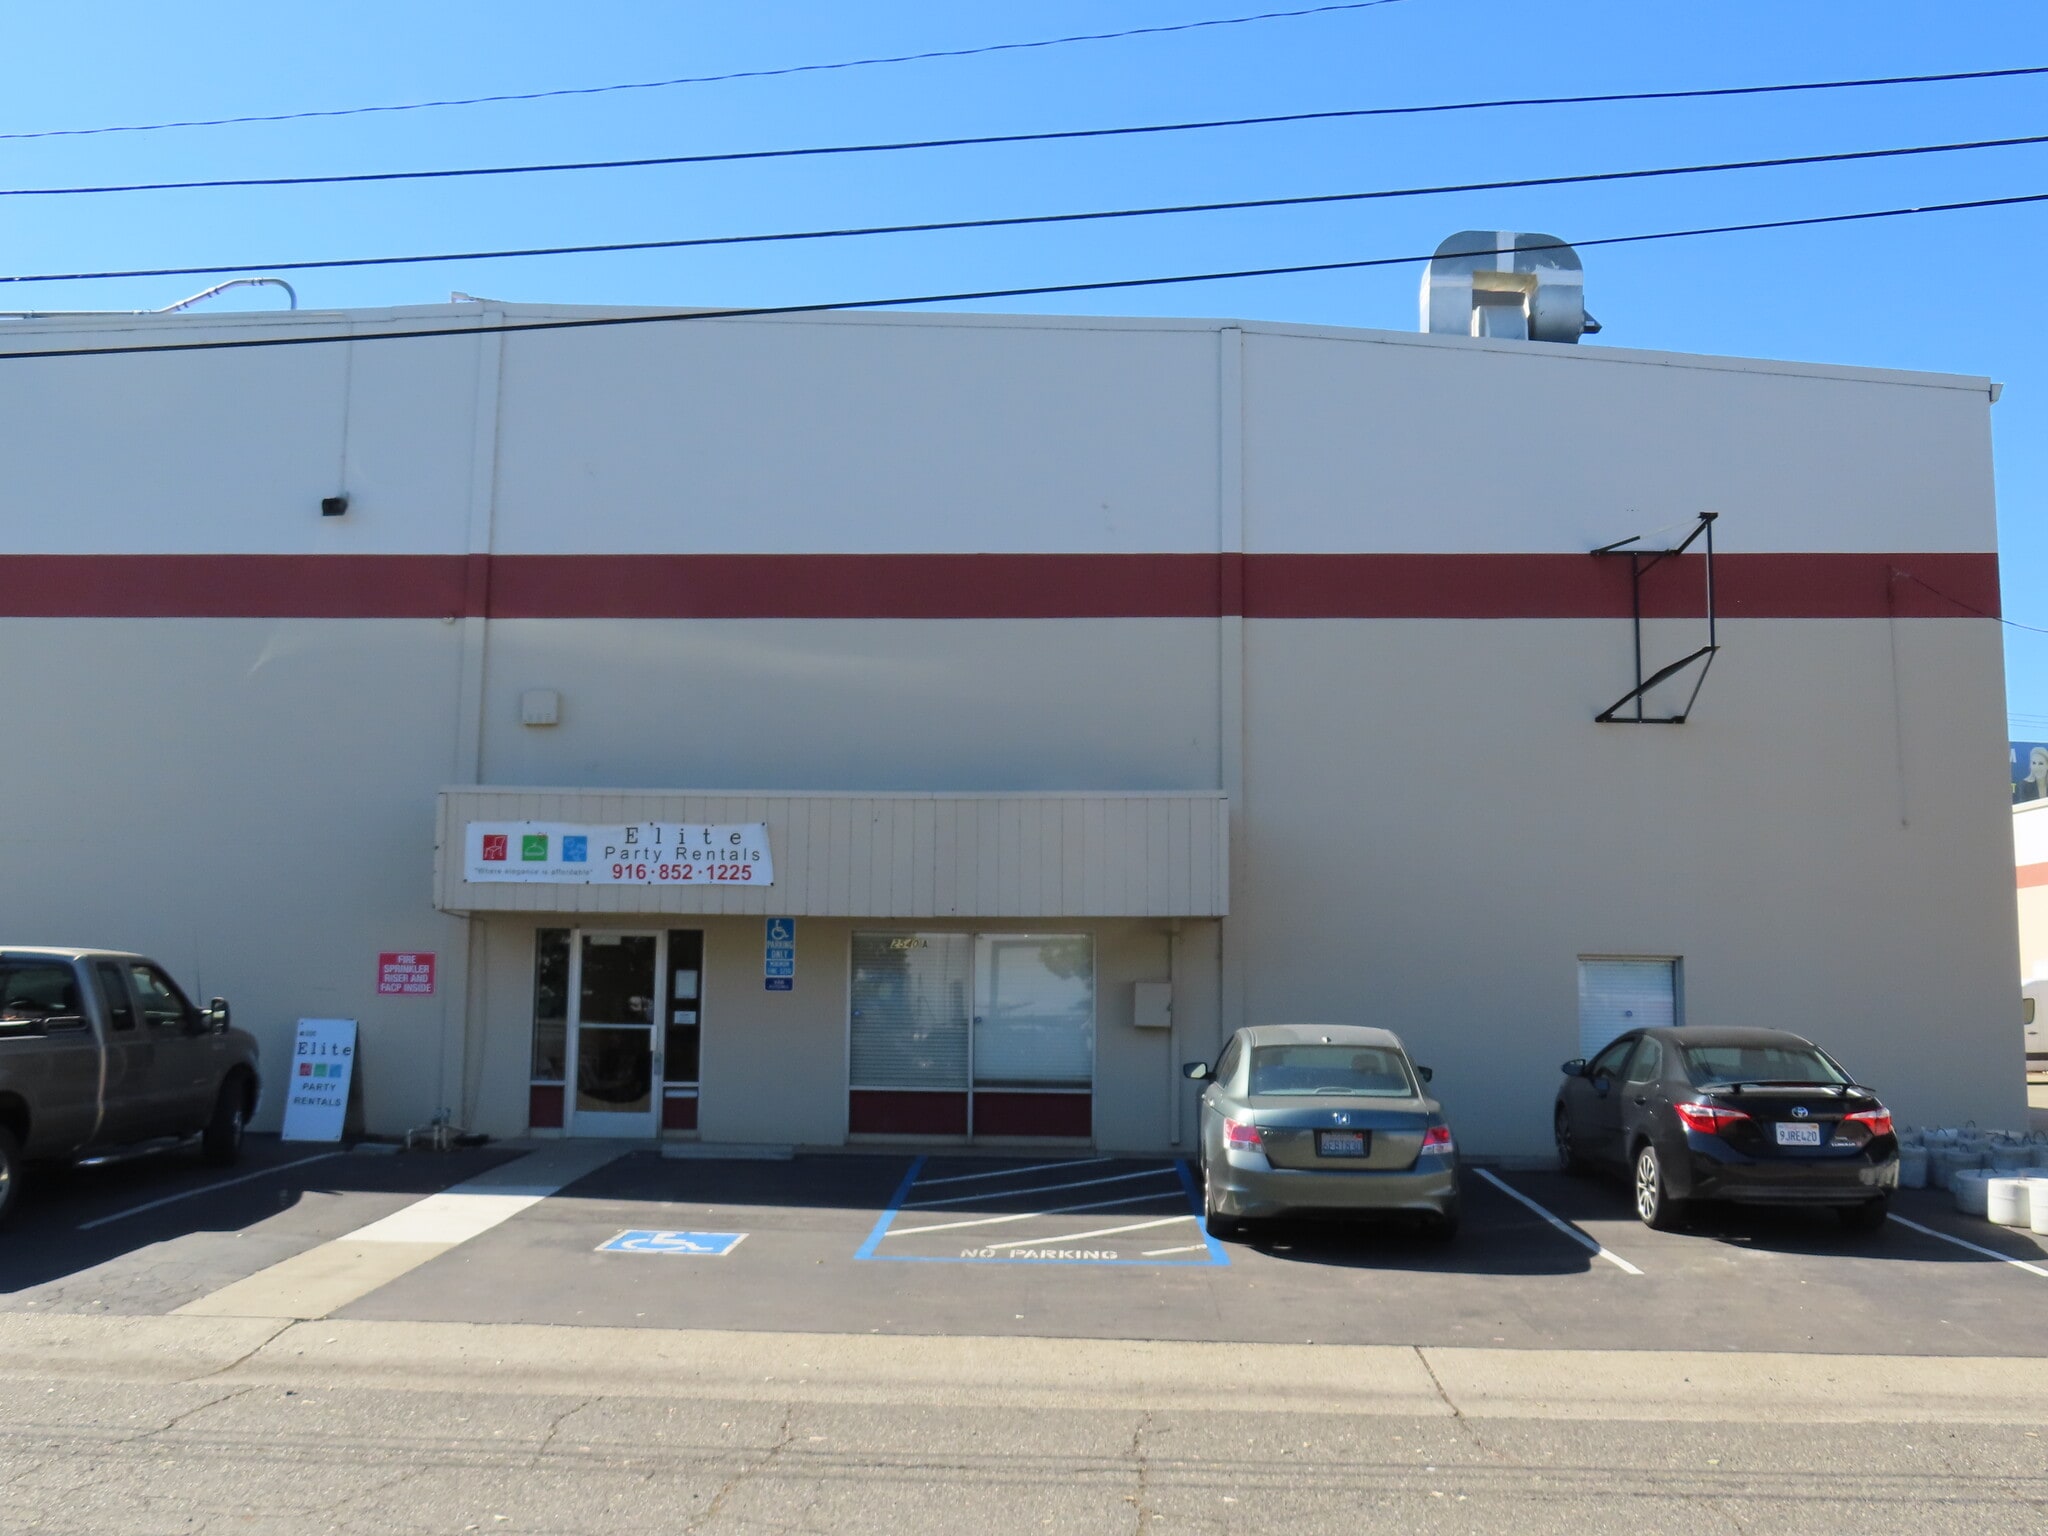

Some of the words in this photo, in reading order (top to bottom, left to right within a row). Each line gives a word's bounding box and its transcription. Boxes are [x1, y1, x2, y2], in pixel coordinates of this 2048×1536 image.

[625, 827, 742, 845] Elite
[604, 846, 662, 863] Party
[676, 847, 760, 861] Rentals
[767, 940, 793, 949] PARKING
[771, 950, 788, 958] ONLY
[398, 955, 416, 964] FIRE
[384, 964, 430, 973] SPRINKLER
[384, 973, 409, 982] RISER
[411, 974, 428, 982] AND
[404, 983, 431, 992] INSIDE
[297, 1041, 352, 1056] Elite
[302, 1082, 337, 1091] PARTY
[293, 1096, 342, 1107] RENTALS
[960, 1248, 996, 1259] NO
[1009, 1249, 1118, 1260] PARKING
